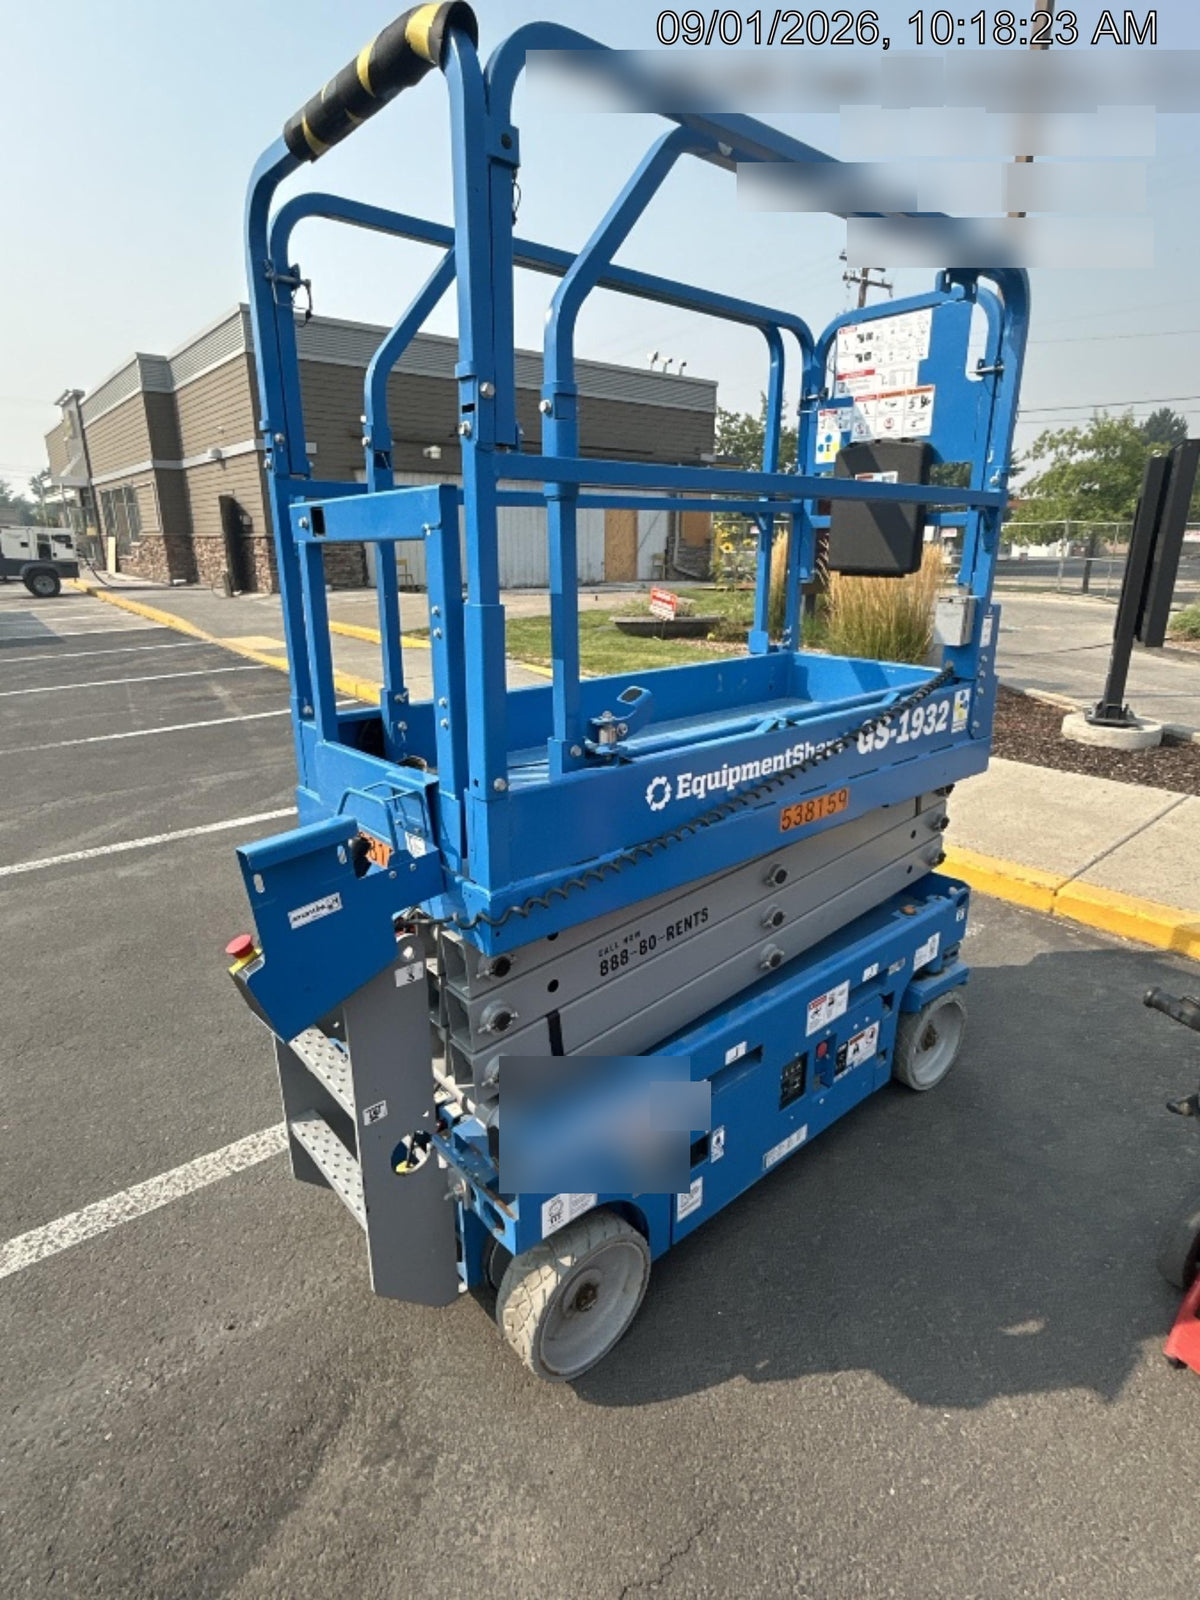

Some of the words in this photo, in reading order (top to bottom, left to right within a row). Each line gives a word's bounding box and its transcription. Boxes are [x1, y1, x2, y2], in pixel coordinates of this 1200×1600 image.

[856, 699, 950, 755] GS-1932
[781, 788, 848, 831] 538159
[599, 906, 709, 977] 888-80-RENTS
